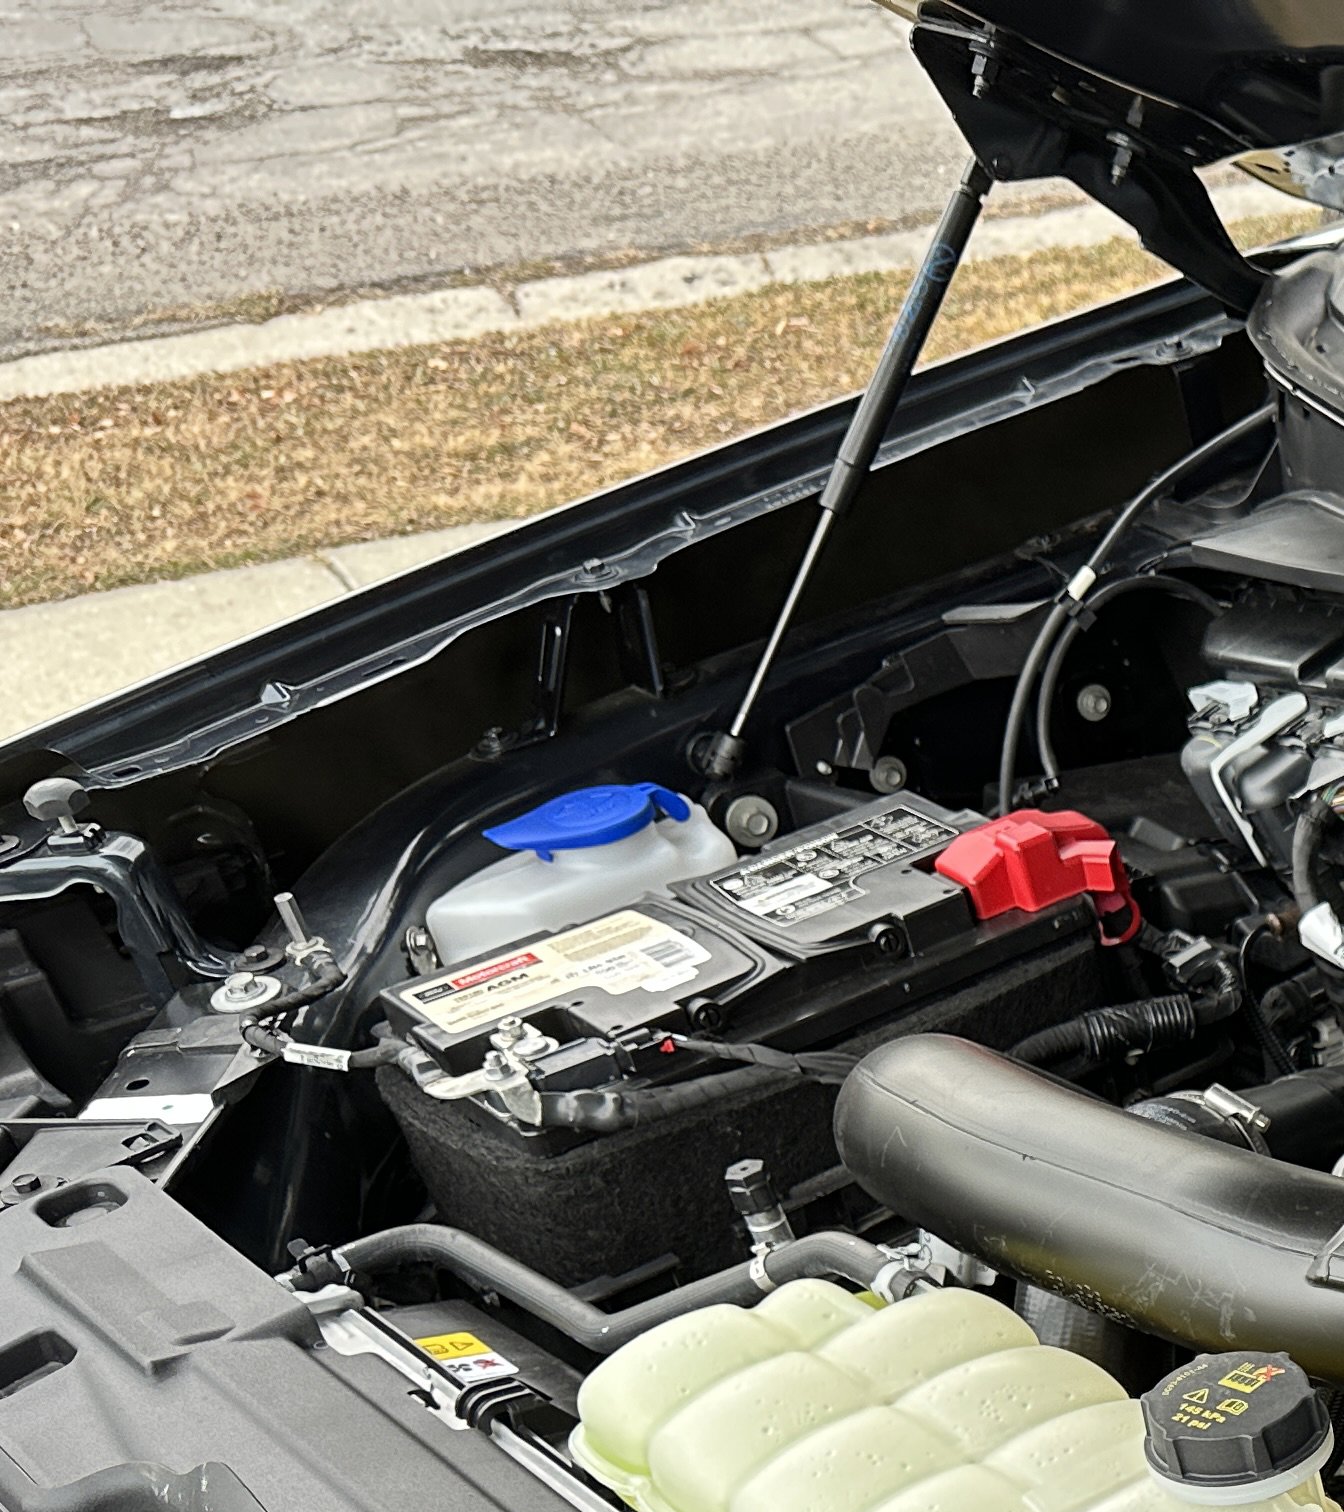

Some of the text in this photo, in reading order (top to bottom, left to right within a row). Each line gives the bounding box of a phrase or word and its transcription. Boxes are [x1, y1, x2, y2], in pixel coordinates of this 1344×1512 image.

[487, 973, 529, 991] AGM
[1171, 1413, 1212, 1430] 21 psi
[1179, 1402, 1226, 1424] 145 kPa
